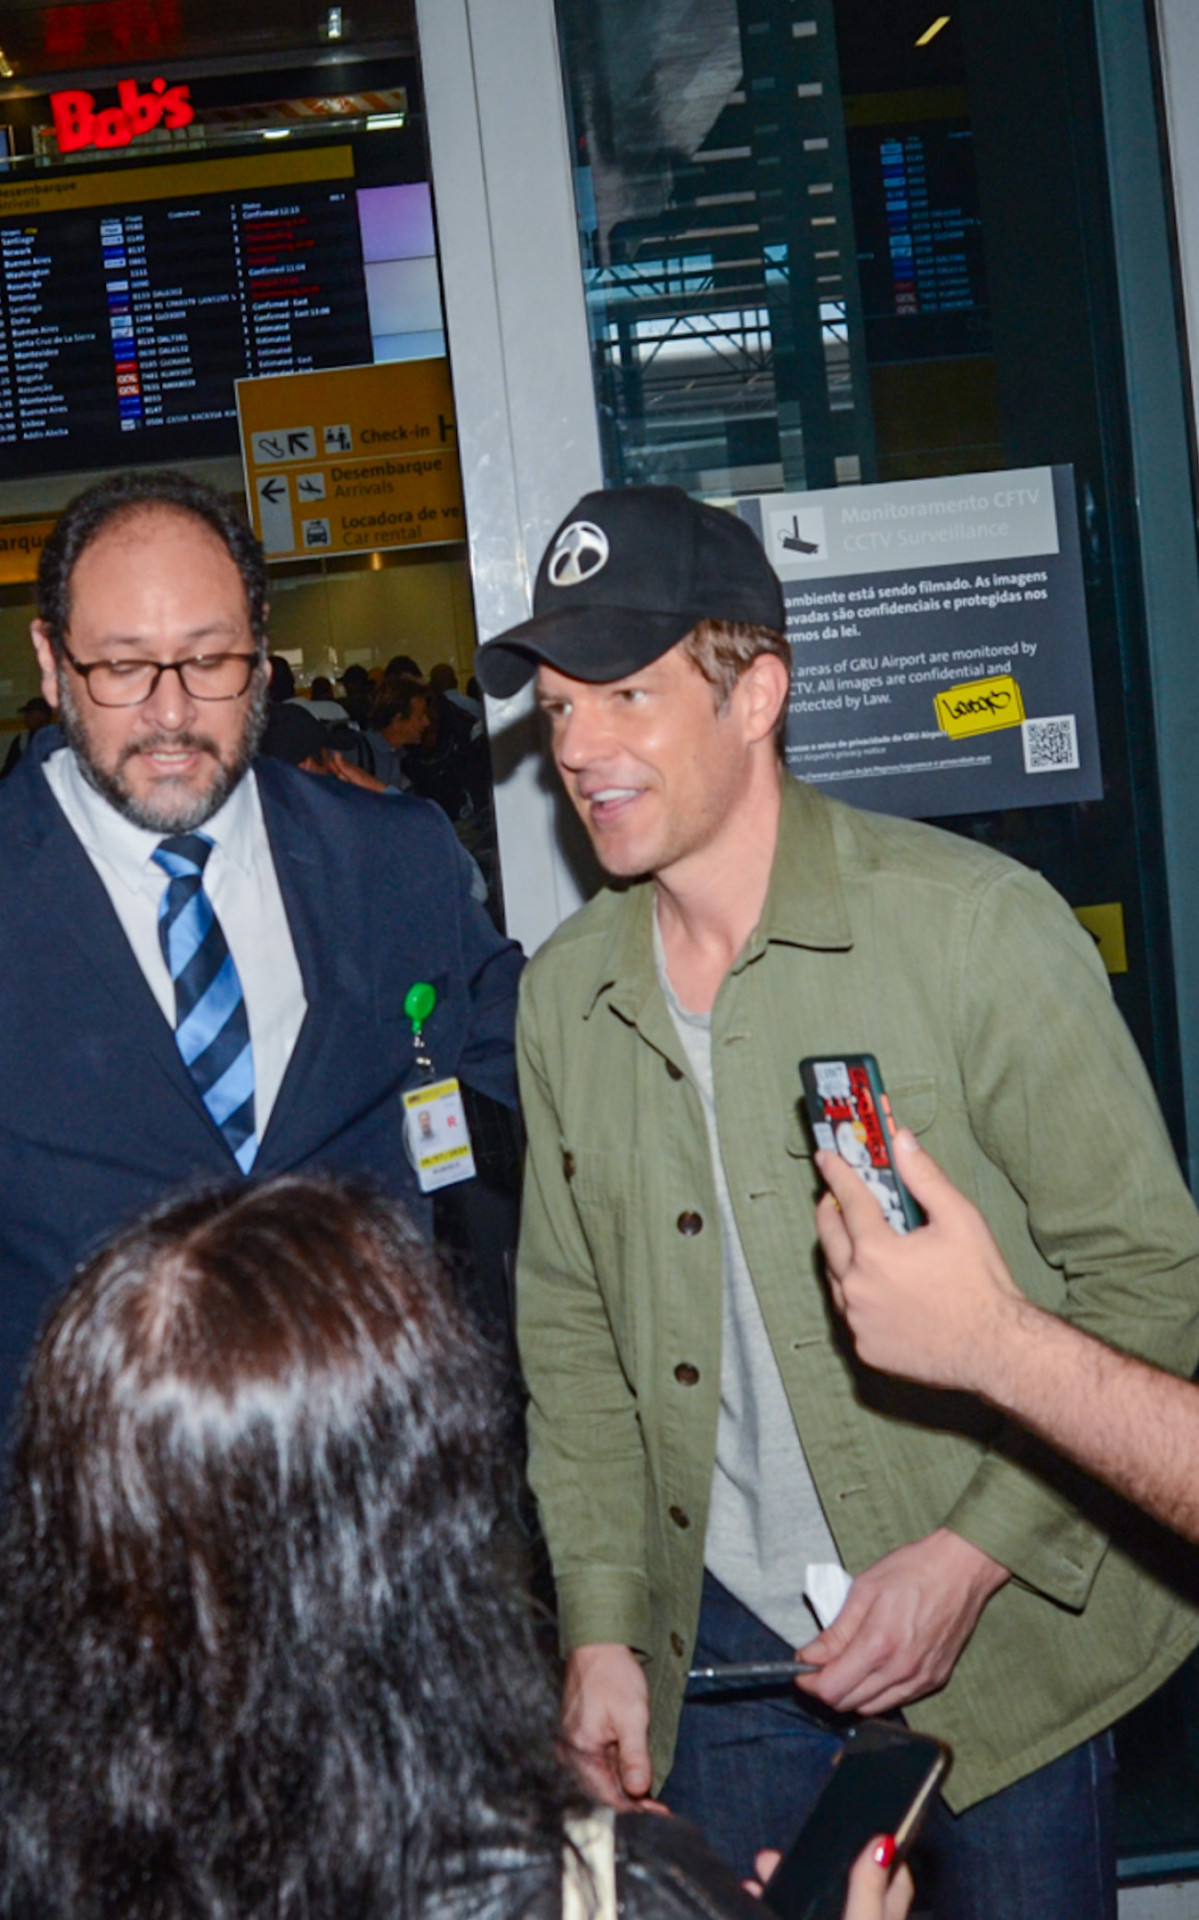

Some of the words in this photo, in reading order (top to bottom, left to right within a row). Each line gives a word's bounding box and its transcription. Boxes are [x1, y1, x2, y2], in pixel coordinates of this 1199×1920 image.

[50, 76, 195, 153] Bob's
[0, 182, 77, 197] esembarque
[14, 347, 59, 360] Montevideo
[19, 393, 65, 406] Montevideo
[360, 424, 430, 444] Check-in
[331, 459, 442, 481] Desembarque
[335, 480, 394, 498] Arrivals
[841, 495, 989, 524] Monitoramento
[993, 488, 1041, 508] CFTV
[341, 509, 413, 529] Locadora
[418, 507, 437, 520] de
[442, 505, 461, 518] ve
[0, 533, 50, 554] arqu
[343, 531, 369, 546] Car
[374, 524, 422, 541] rental
[843, 532, 893, 553] CCTV
[898, 520, 1009, 546] Surveillance
[784, 591, 846, 608] ambiente
[848, 586, 876, 601] está
[878, 582, 917, 599] sendo
[918, 578, 972, 594] filmado.
[975, 575, 991, 588] As
[992, 571, 1048, 588] imagens
[785, 611, 829, 626] avadas
[832, 607, 855, 621] são
[857, 597, 941, 619] confidenciais
[943, 599, 951, 609] e
[953, 590, 1022, 612] protegidas
[1024, 588, 1048, 601] nos
[786, 630, 820, 643] rmos
[822, 626, 839, 640] da
[840, 623, 861, 638] lei.
[797, 664, 832, 678] areas
[833, 659, 848, 674] of
[850, 657, 878, 672] GRU
[881, 652, 926, 670] Airport
[928, 651, 950, 663] are
[952, 642, 1019, 660] monitored
[1021, 640, 1037, 657] by
[817, 678, 835, 692] All
[837, 677, 883, 692] images
[886, 673, 906, 685] are
[908, 663, 985, 683] confidential
[986, 660, 1012, 674] and
[790, 696, 842, 712] rotected
[844, 694, 861, 710] by
[863, 693, 892, 706] Law.
[903, 732, 920, 742] GRU
[836, 748, 862, 761] privacy
